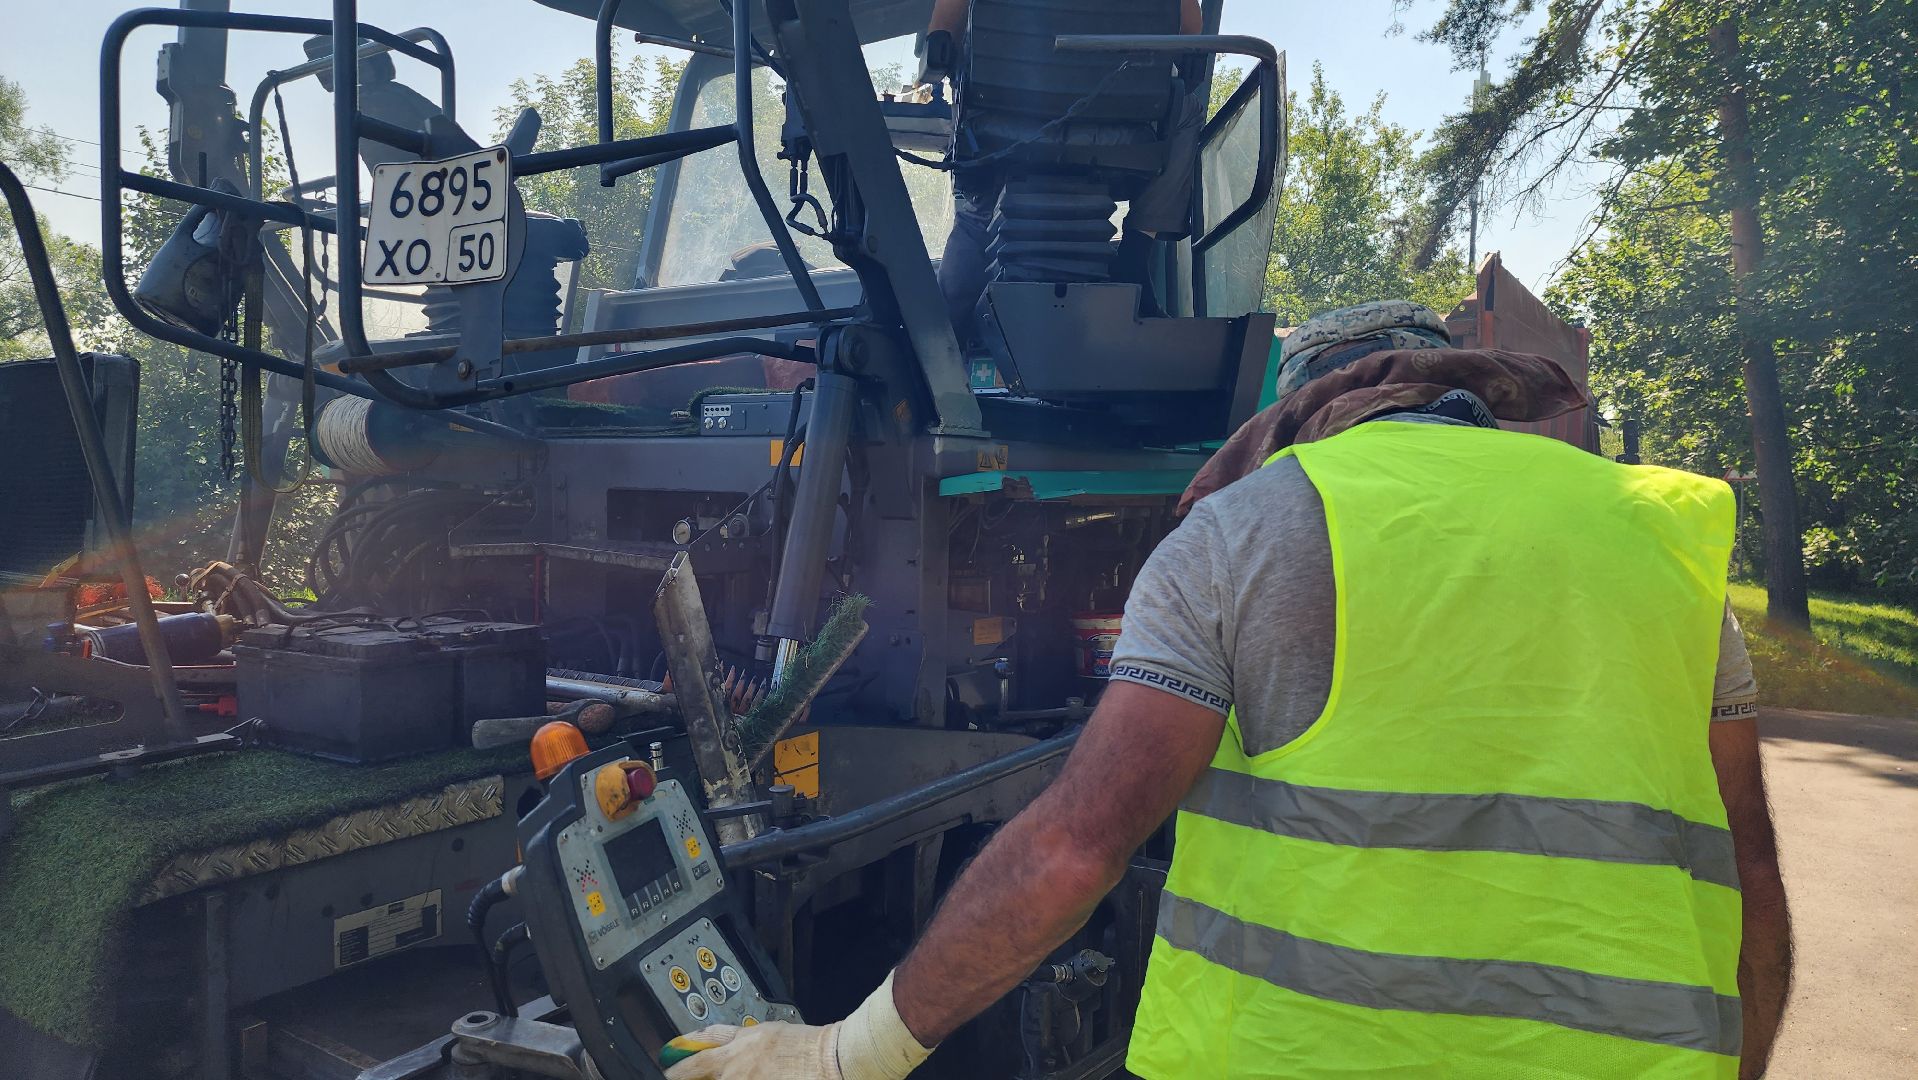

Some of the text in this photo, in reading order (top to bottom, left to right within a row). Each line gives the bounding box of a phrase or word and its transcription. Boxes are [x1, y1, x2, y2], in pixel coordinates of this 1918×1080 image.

[390, 160, 492, 218] 6895
[458, 232, 495, 272] 50
[710, 985, 722, 999] R
